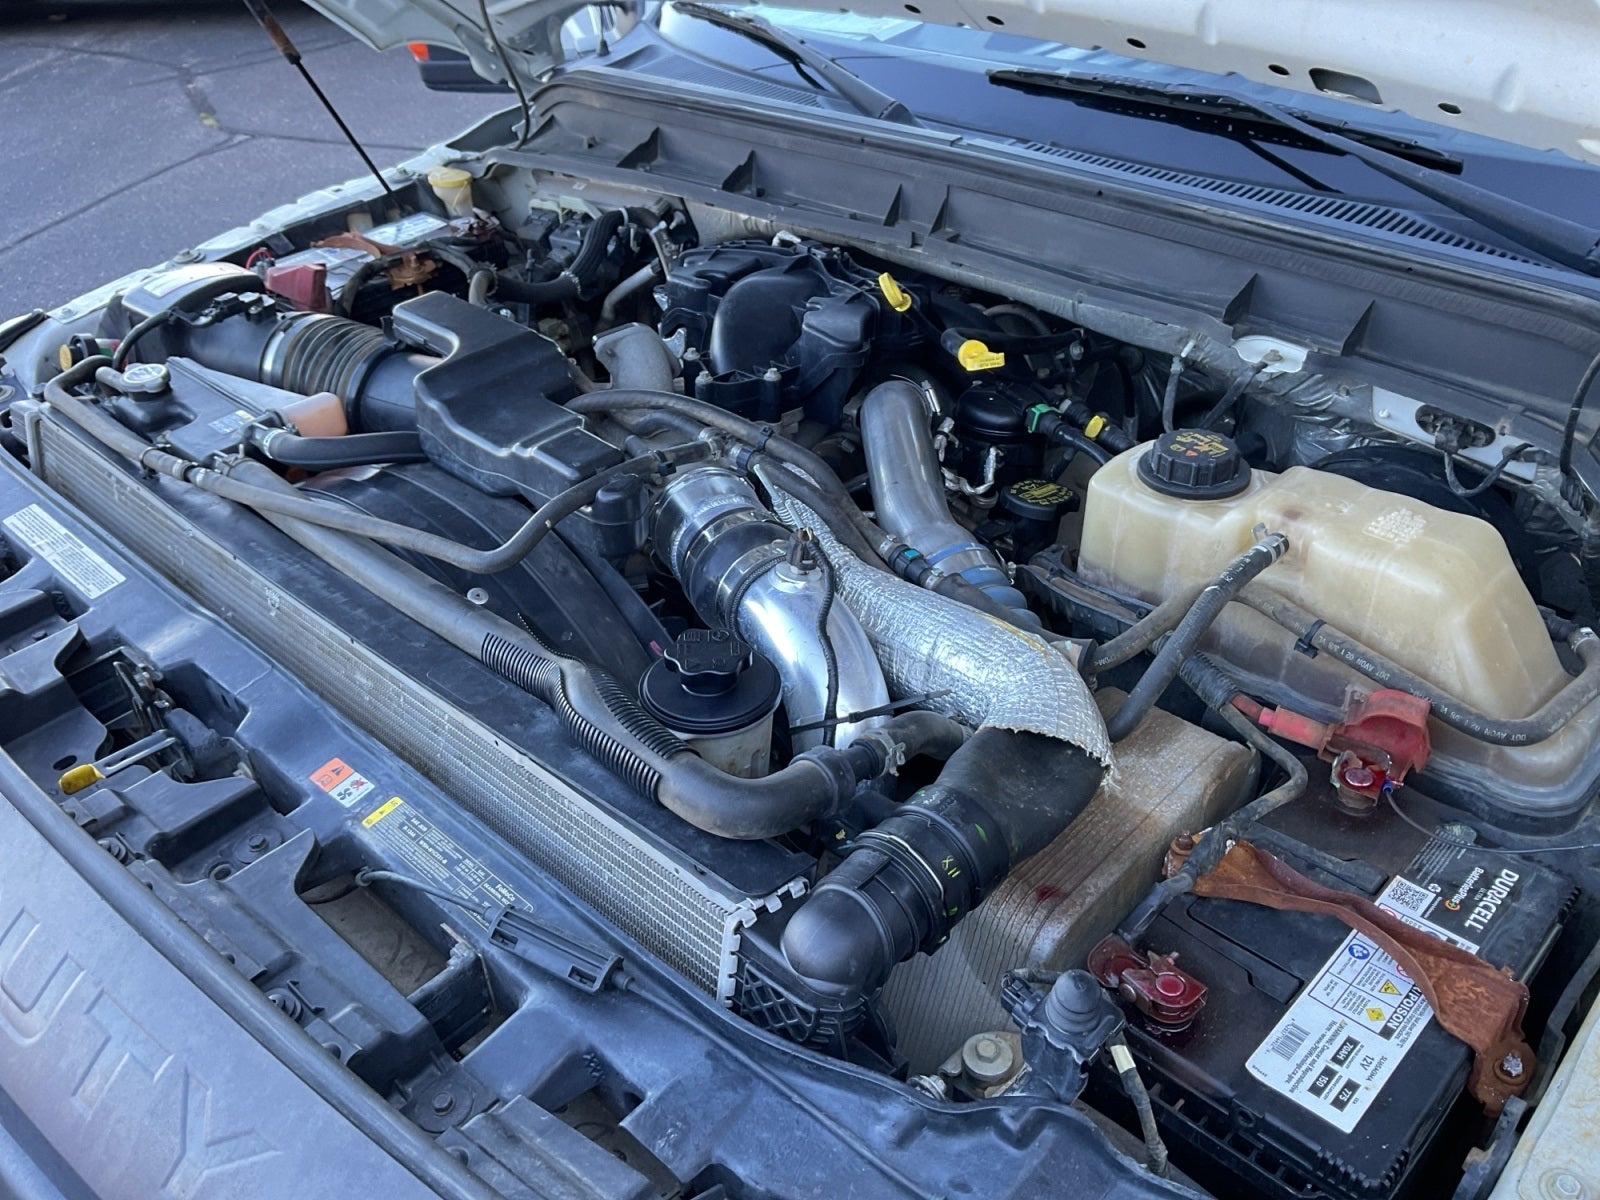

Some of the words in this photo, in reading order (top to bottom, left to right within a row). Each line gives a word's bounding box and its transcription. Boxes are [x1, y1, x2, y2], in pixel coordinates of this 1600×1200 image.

[1356, 657, 1374, 671] AVON
[1484, 728, 1507, 736] AVON
[495, 883, 516, 902] FoMoCo
[1451, 866, 1484, 905] BatteriesPlus
[1464, 868, 1520, 933] DURACELL
[1324, 1020, 1336, 1032] Harm
[1315, 1044, 1329, 1060] Cancer
[1336, 1042, 1354, 1060] 70AH
[1309, 1058, 1319, 1068] and
[1359, 1054, 1375, 1070] 12V
[1288, 1065, 1313, 1094] Reproductive
[1315, 1075, 1328, 1087] 150
[1338, 1087, 1352, 1101] 775
